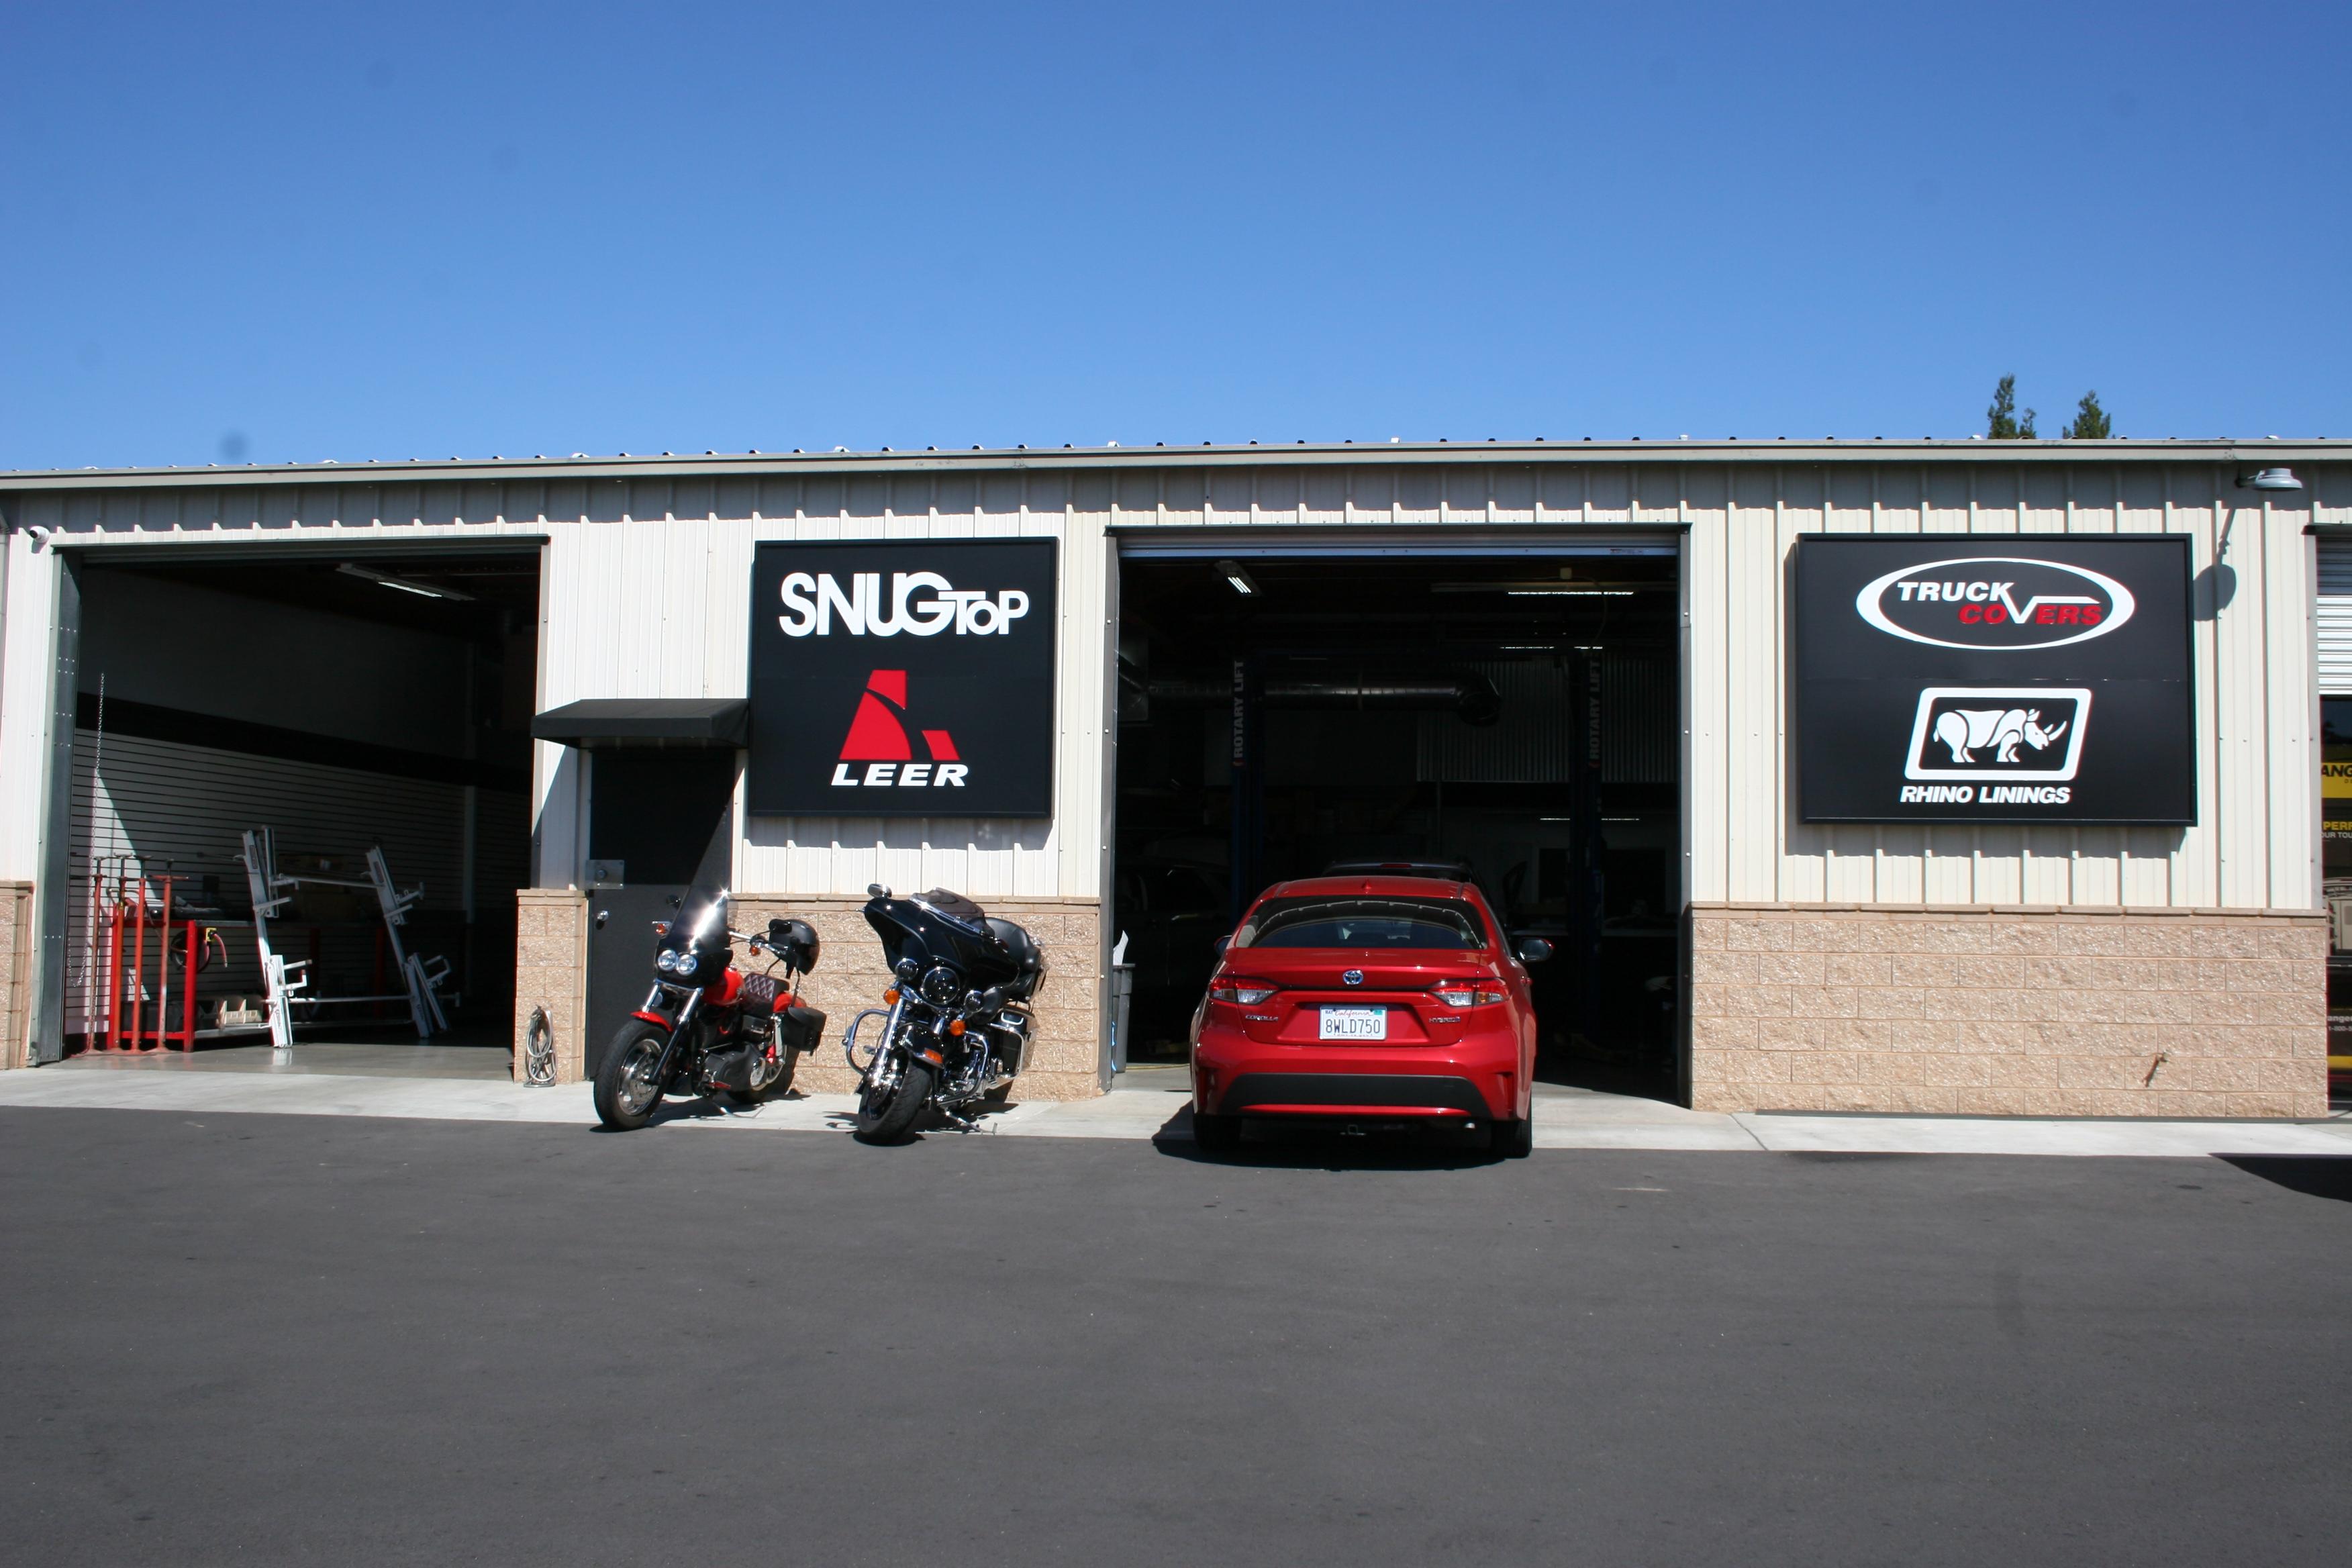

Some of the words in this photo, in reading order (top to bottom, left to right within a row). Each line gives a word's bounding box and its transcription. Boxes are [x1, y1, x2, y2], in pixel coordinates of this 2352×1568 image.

[1897, 581, 2014, 601] TRUCK
[1958, 601, 2102, 625] COVERS
[1234, 660, 1244, 692] LIFT
[1589, 660, 1600, 693] LIFT
[1234, 697, 1244, 758] ROTARY
[1589, 696, 1600, 760] ROTARY
[831, 763, 969, 787] LEER
[1900, 786, 1973, 803] RHINO
[1979, 786, 2071, 803] LININGS
[1335, 1010, 1373, 1018] California
[1326, 1019, 1380, 1034] 8WLD750
